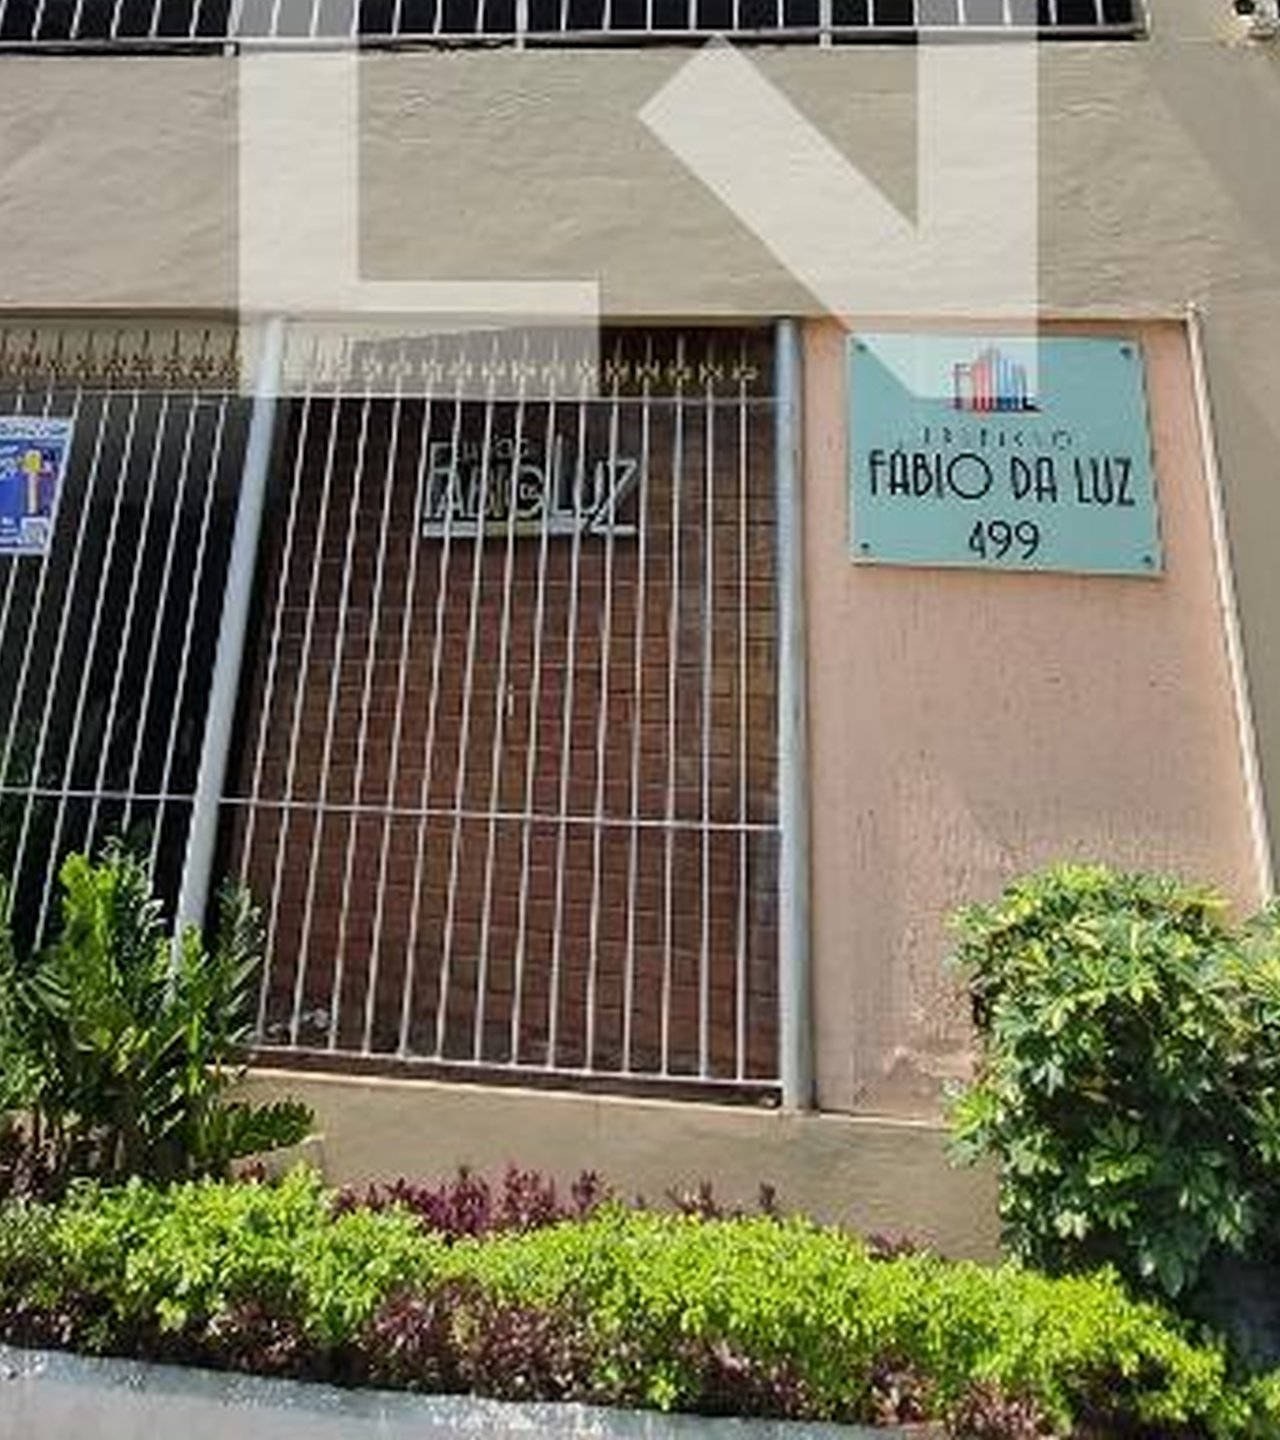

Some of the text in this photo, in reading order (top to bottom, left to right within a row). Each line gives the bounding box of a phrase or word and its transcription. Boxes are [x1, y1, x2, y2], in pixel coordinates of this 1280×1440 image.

[868, 442, 1135, 506] FÁBIO DA LUZ
[968, 519, 1040, 560] 499
